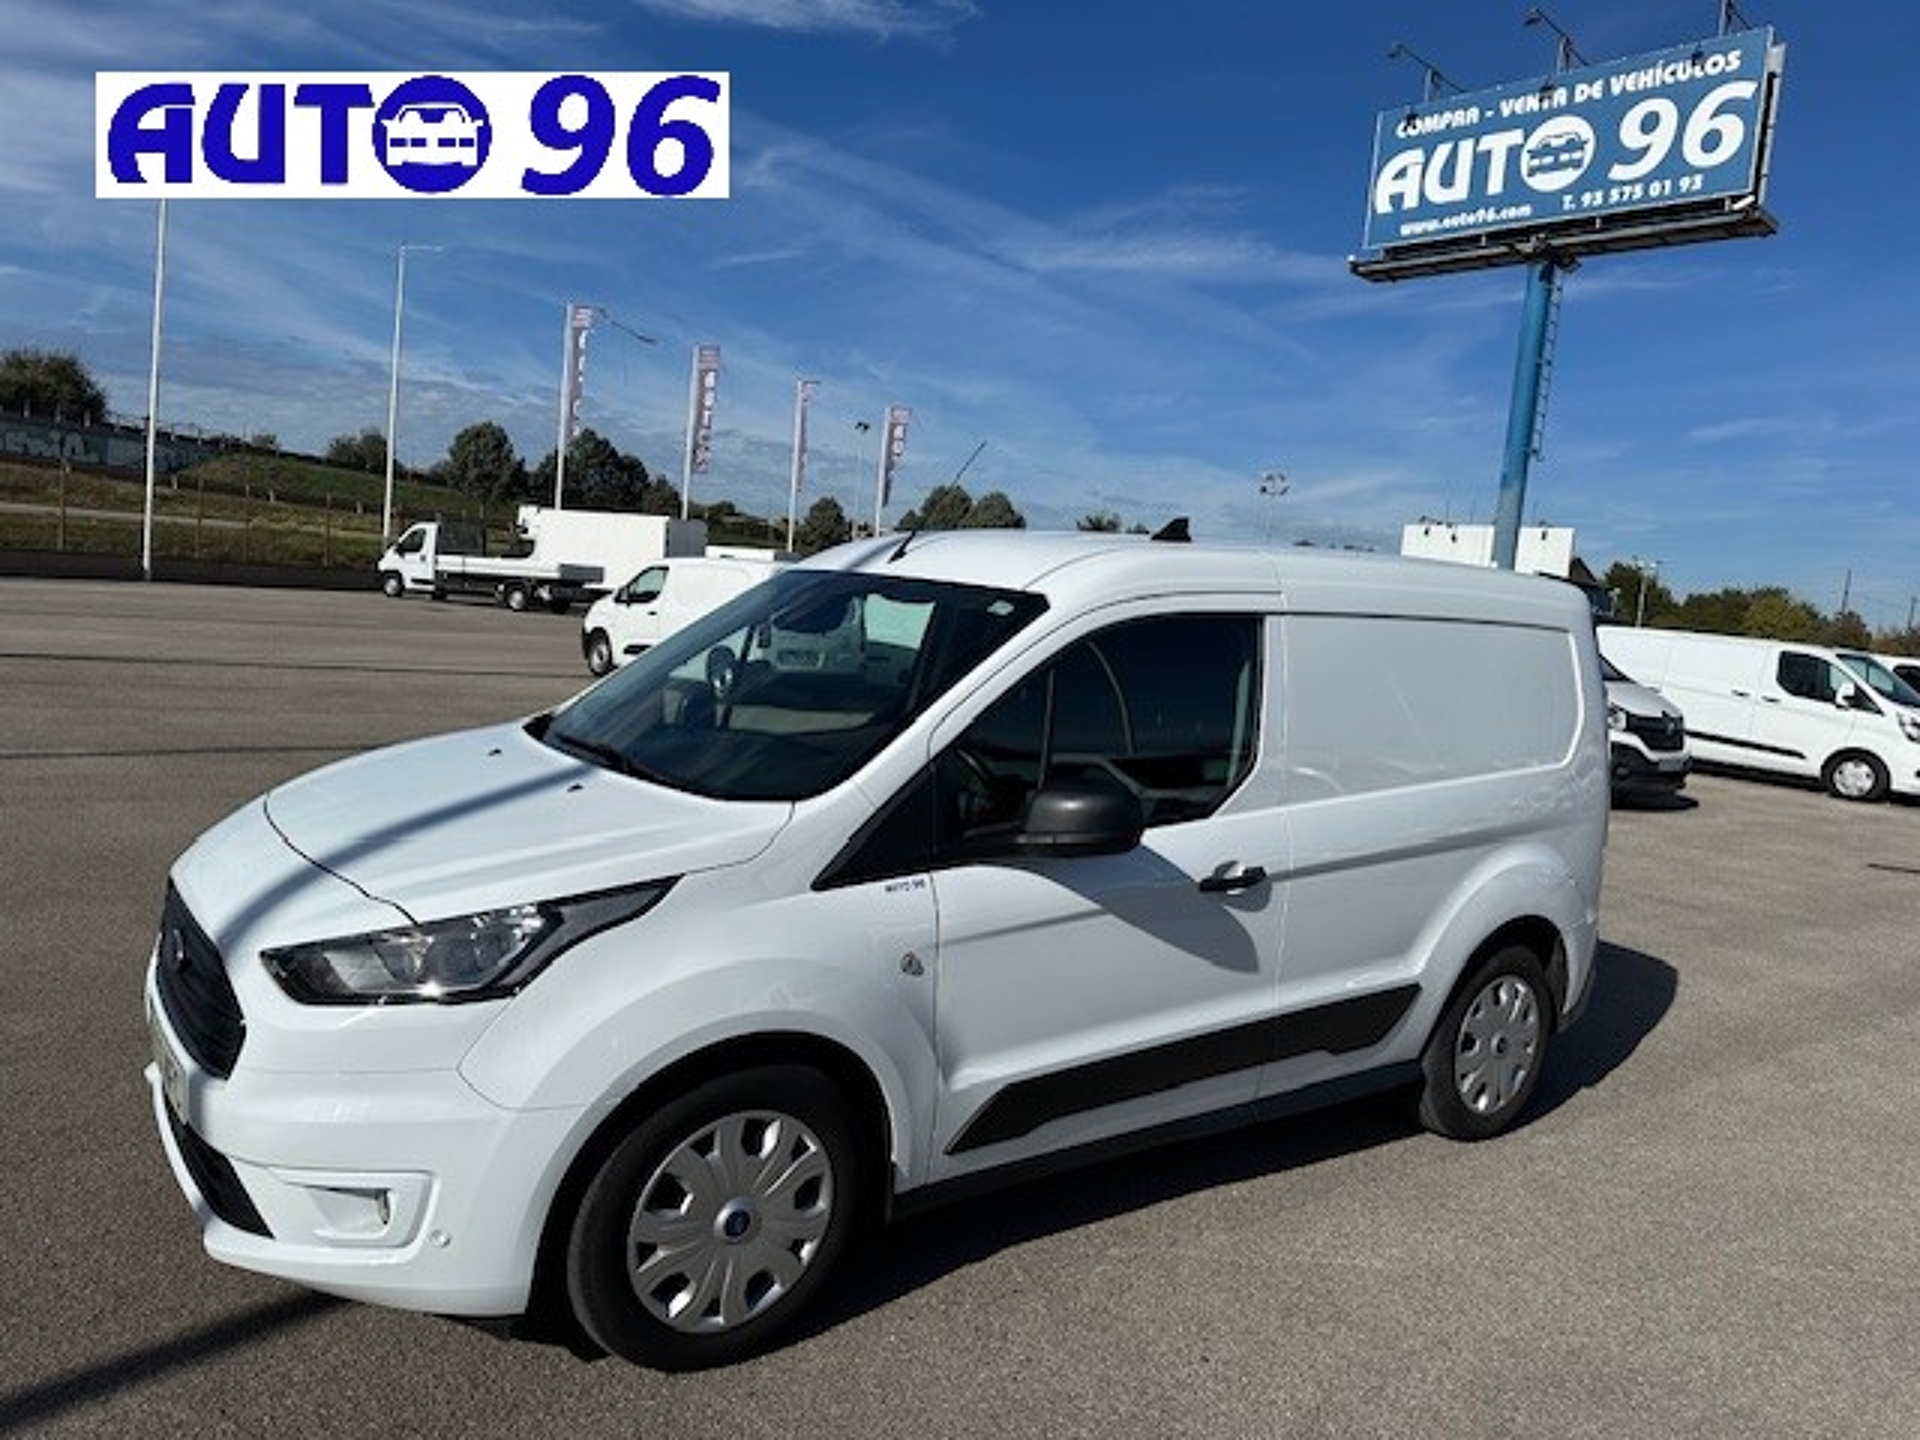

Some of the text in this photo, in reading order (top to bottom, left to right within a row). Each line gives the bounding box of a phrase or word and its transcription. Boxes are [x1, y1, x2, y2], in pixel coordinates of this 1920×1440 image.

[1396, 105, 1480, 138] COMPRA
[1574, 78, 1603, 104] DE
[1375, 80, 1758, 214] AUTO 96
[1608, 183, 1644, 204] 575
[1649, 180, 1672, 197] 01
[1400, 204, 1531, 235] www.auto96.com
